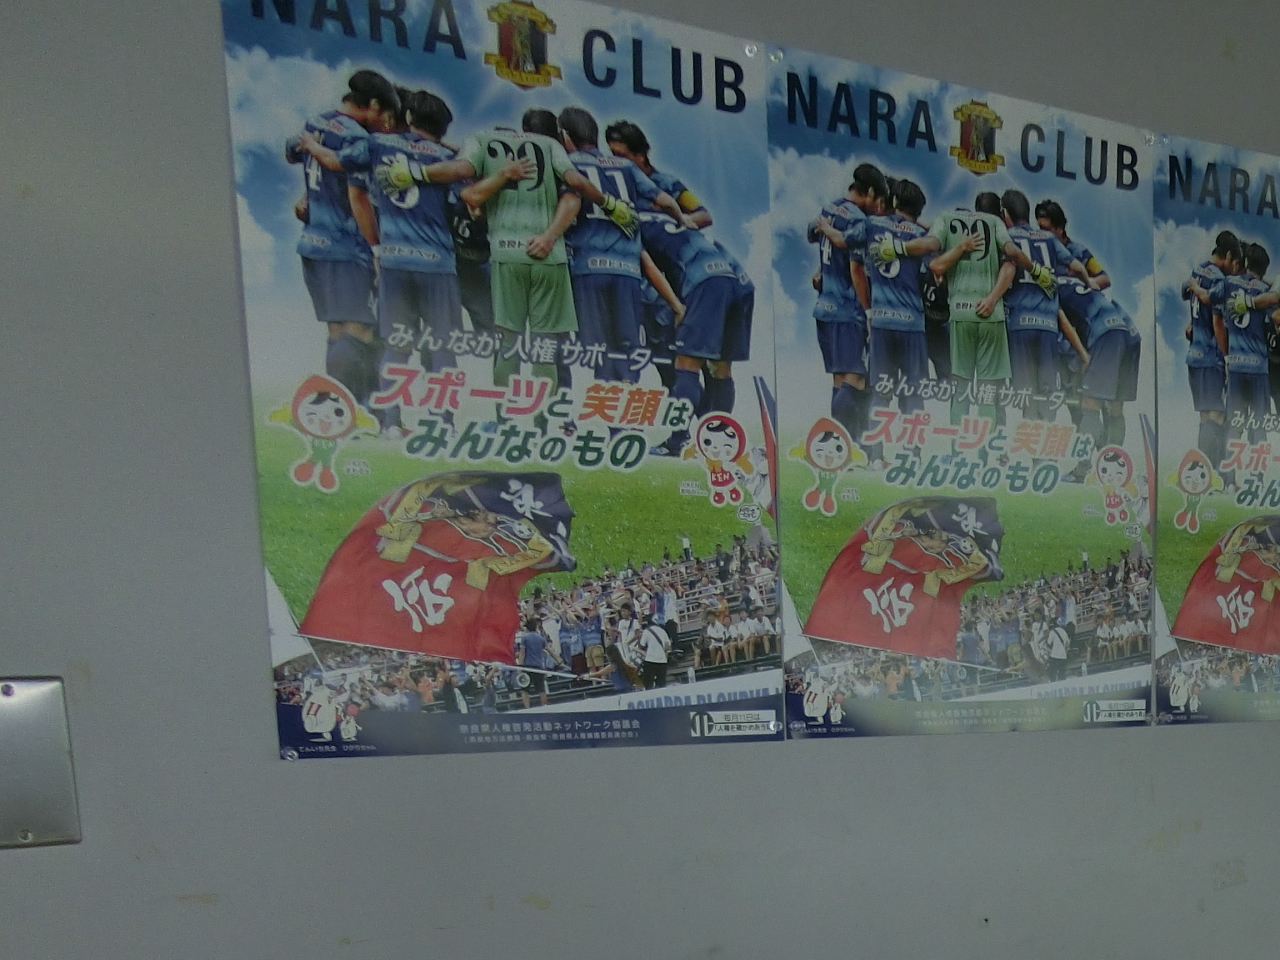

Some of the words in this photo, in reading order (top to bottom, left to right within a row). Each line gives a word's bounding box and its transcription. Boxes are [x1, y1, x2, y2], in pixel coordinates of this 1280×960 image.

[582, 28, 748, 113] CLUB
[787, 71, 938, 153] NARA
[1020, 123, 1139, 191] CLUB
[1168, 154, 1280, 220] NARA
[387, 322, 673, 372] みんなが人権サポーター
[372, 366, 690, 430] スポーツと笑顔は
[875, 373, 1081, 410] みんなが人権サポーター
[406, 418, 650, 470] みんなのもの
[865, 409, 1092, 460] スポーツと笑顔は
[711, 472, 730, 483] KEN
[886, 454, 1060, 494] みんなのもの
